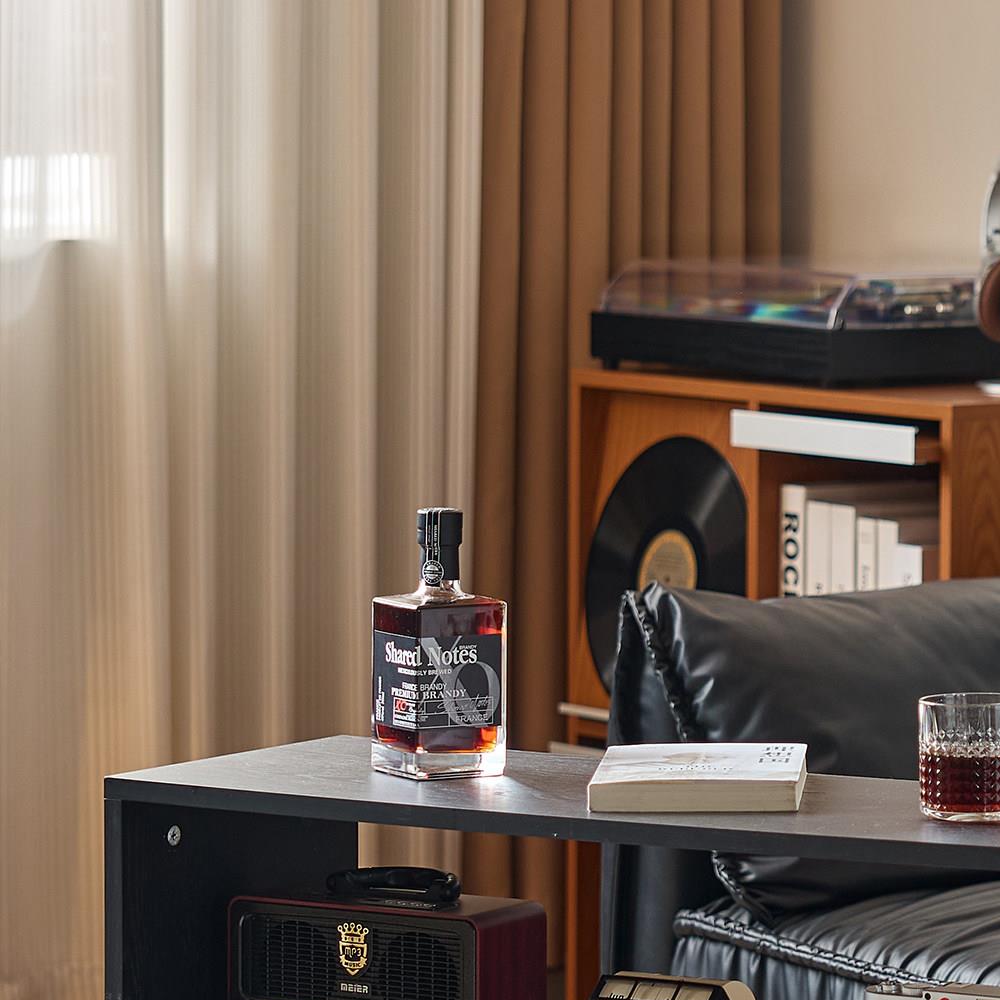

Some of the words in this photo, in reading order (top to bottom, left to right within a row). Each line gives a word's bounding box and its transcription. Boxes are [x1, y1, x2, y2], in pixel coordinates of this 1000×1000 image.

[385, 641, 422, 667] Shared
[427, 645, 478, 667] Notes
[420, 683, 447, 692] BRANDY
[423, 688, 467, 700] BRANDY
[455, 713, 488, 723] FRANCE
[345, 947, 361, 958] MP3
[341, 983, 369, 994] MEIER
